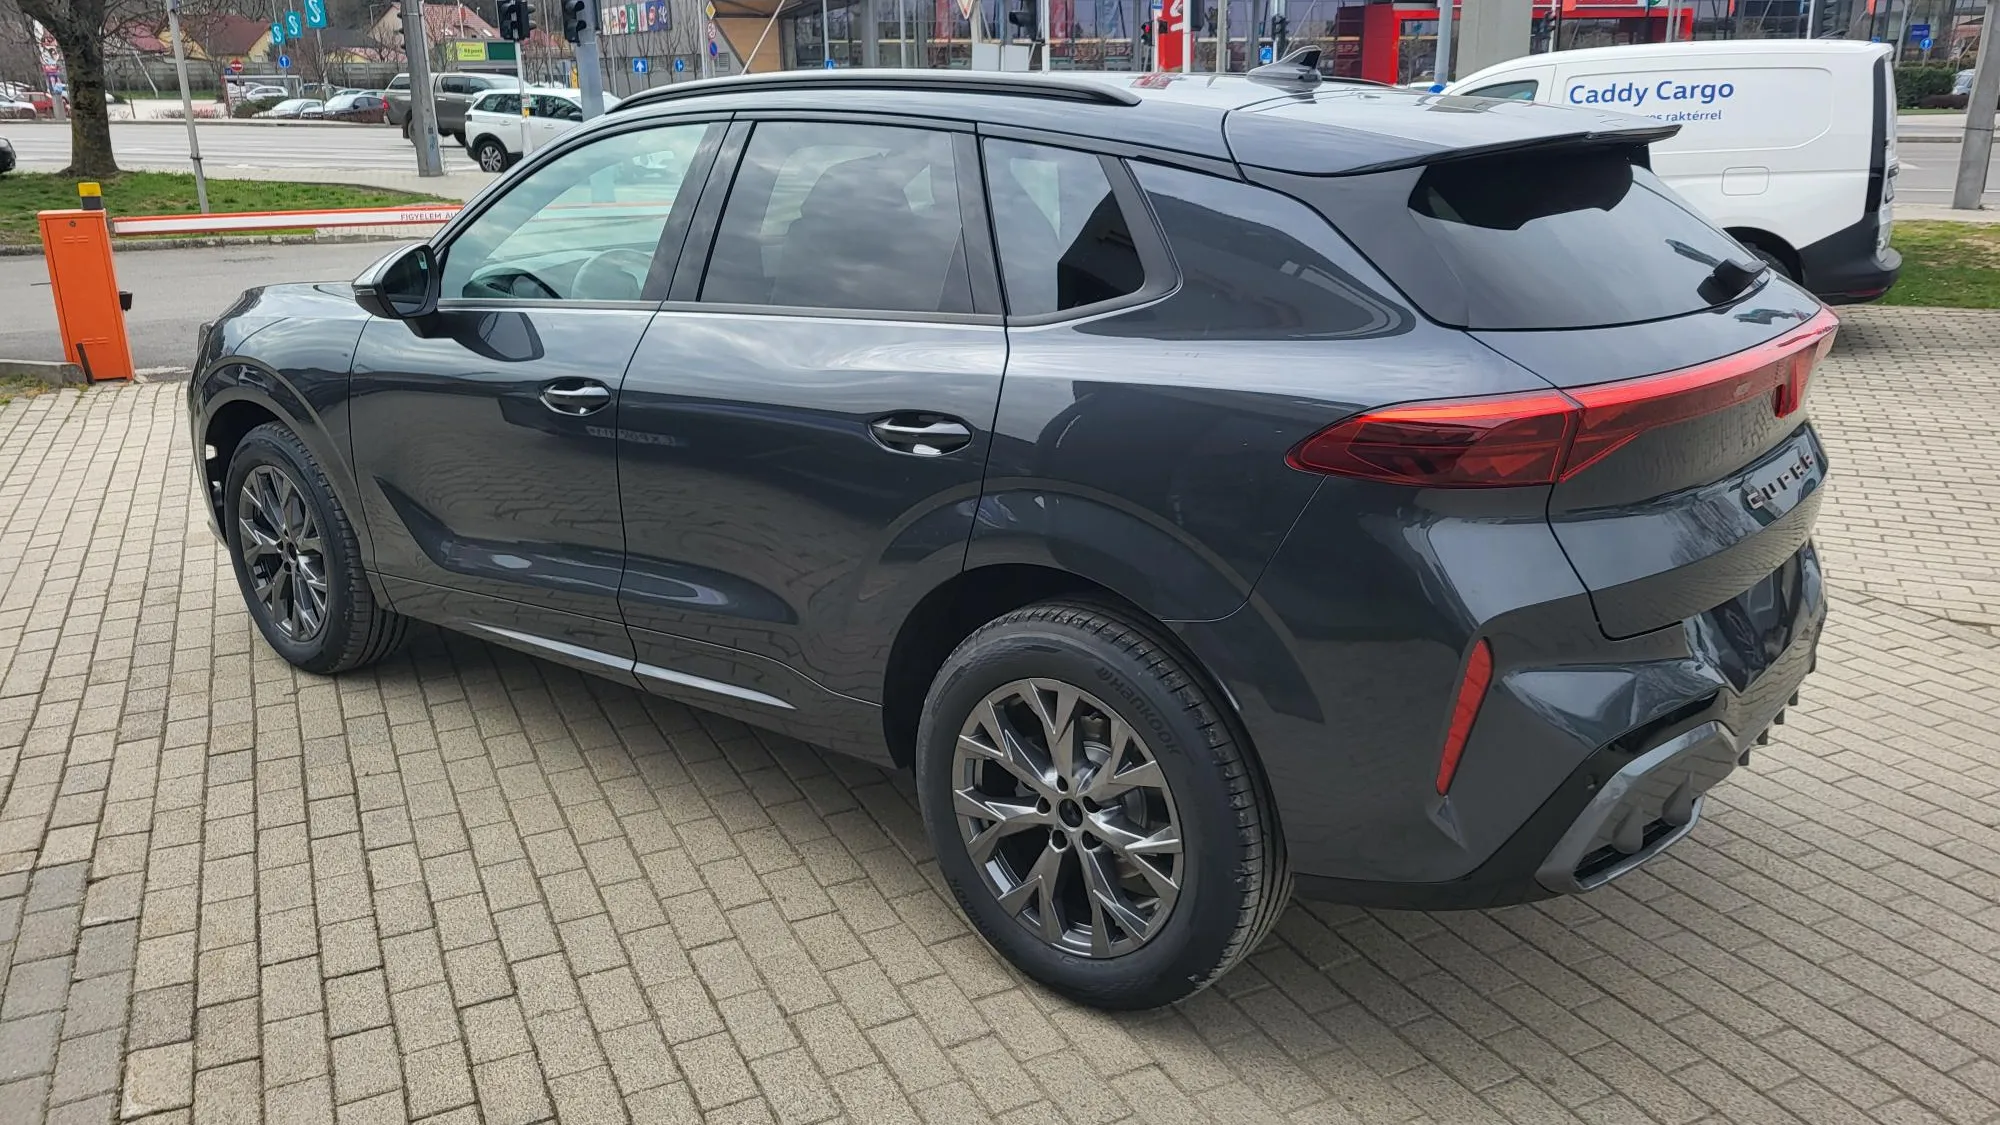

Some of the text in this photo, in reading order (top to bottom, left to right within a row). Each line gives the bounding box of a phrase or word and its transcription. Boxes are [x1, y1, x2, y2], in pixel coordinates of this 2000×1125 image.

[1569, 80, 1734, 107] Caddy Cargo
[1666, 110, 1722, 121] raktérrel
[400, 212, 442, 221] FIGYELEM
